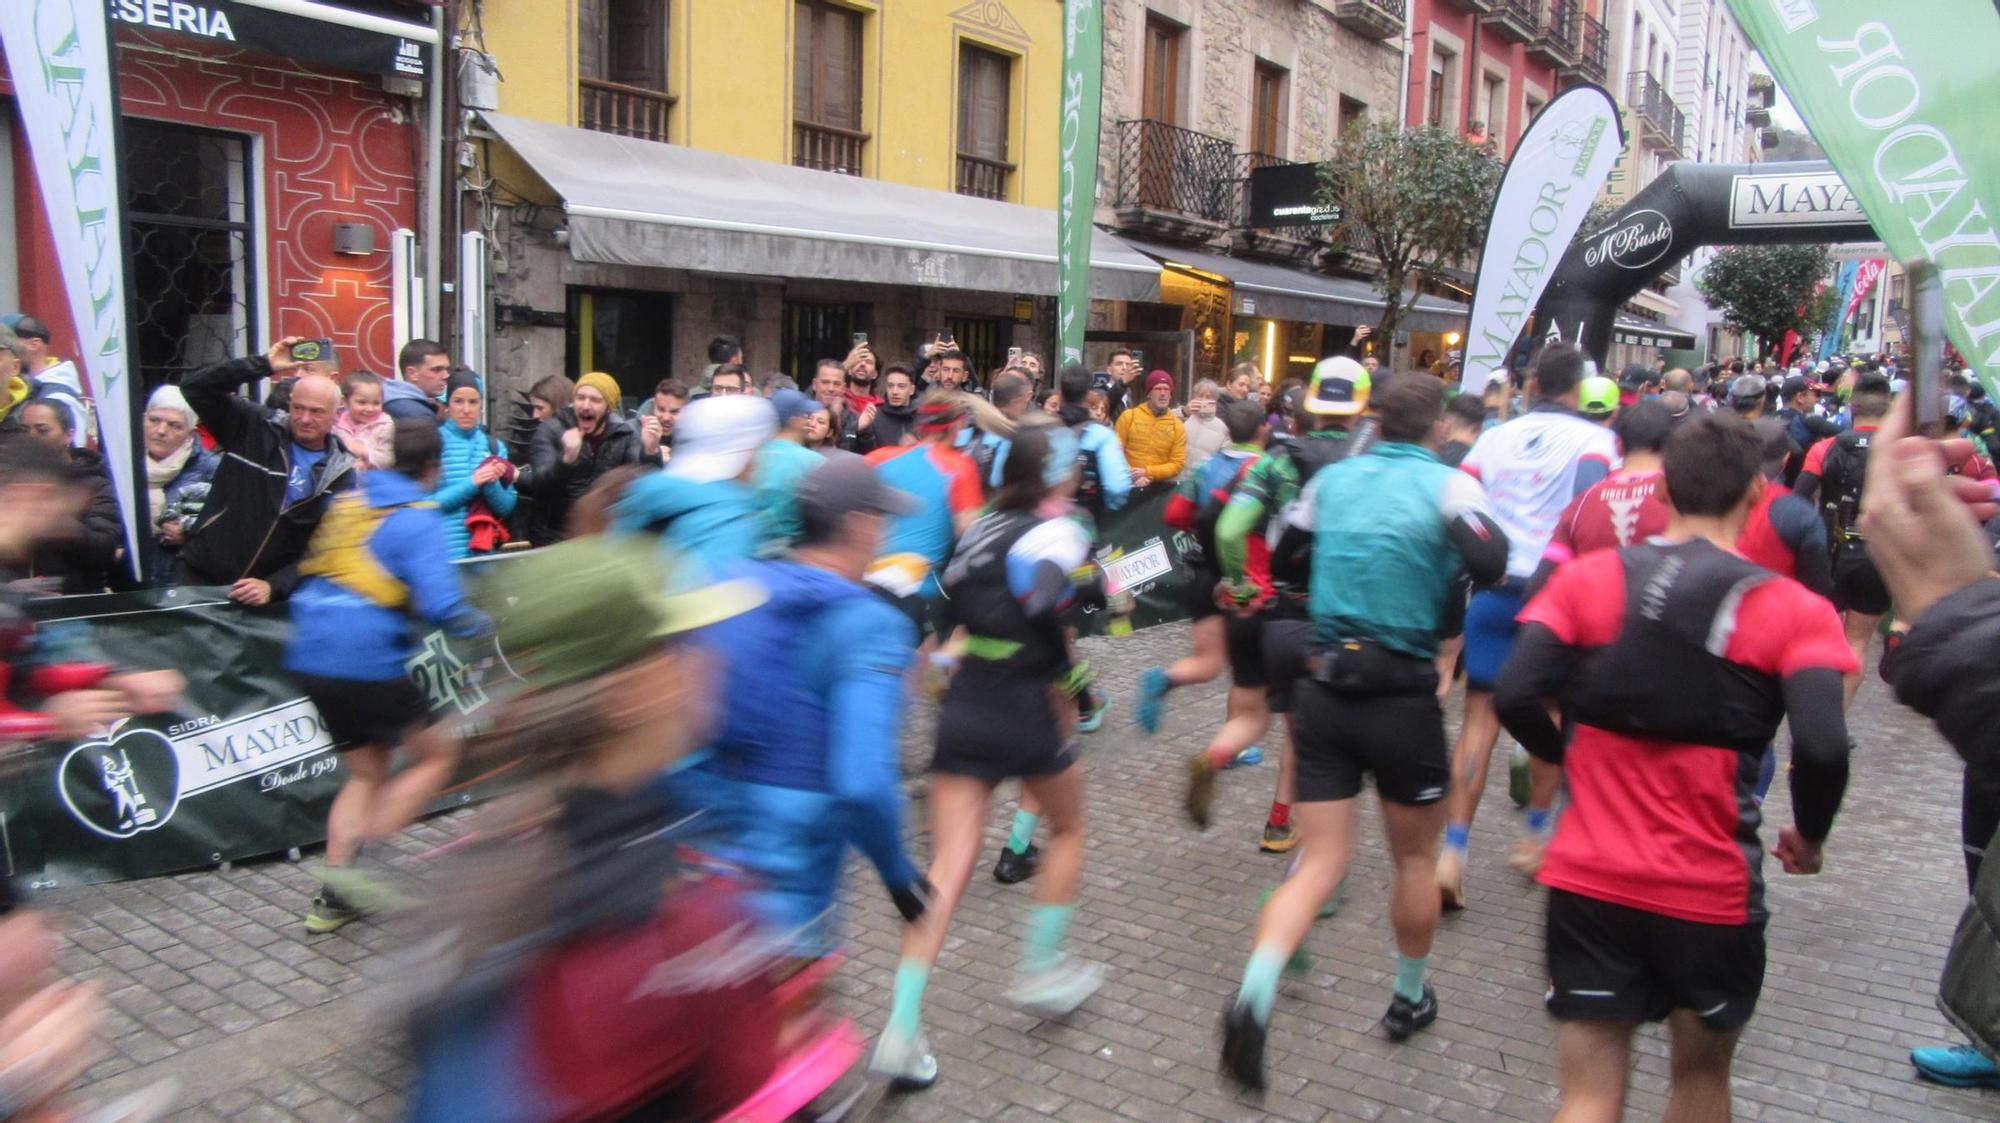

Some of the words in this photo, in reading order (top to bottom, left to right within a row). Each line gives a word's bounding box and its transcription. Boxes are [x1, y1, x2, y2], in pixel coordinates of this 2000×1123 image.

[111, 0, 236, 41] SERIA
[1469, 181, 1572, 371] MAYADOR
[168, 714, 222, 737] SIDRA
[198, 714, 328, 772] MAYAD
[261, 760, 308, 793] Desde
[311, 757, 338, 777] 1939
